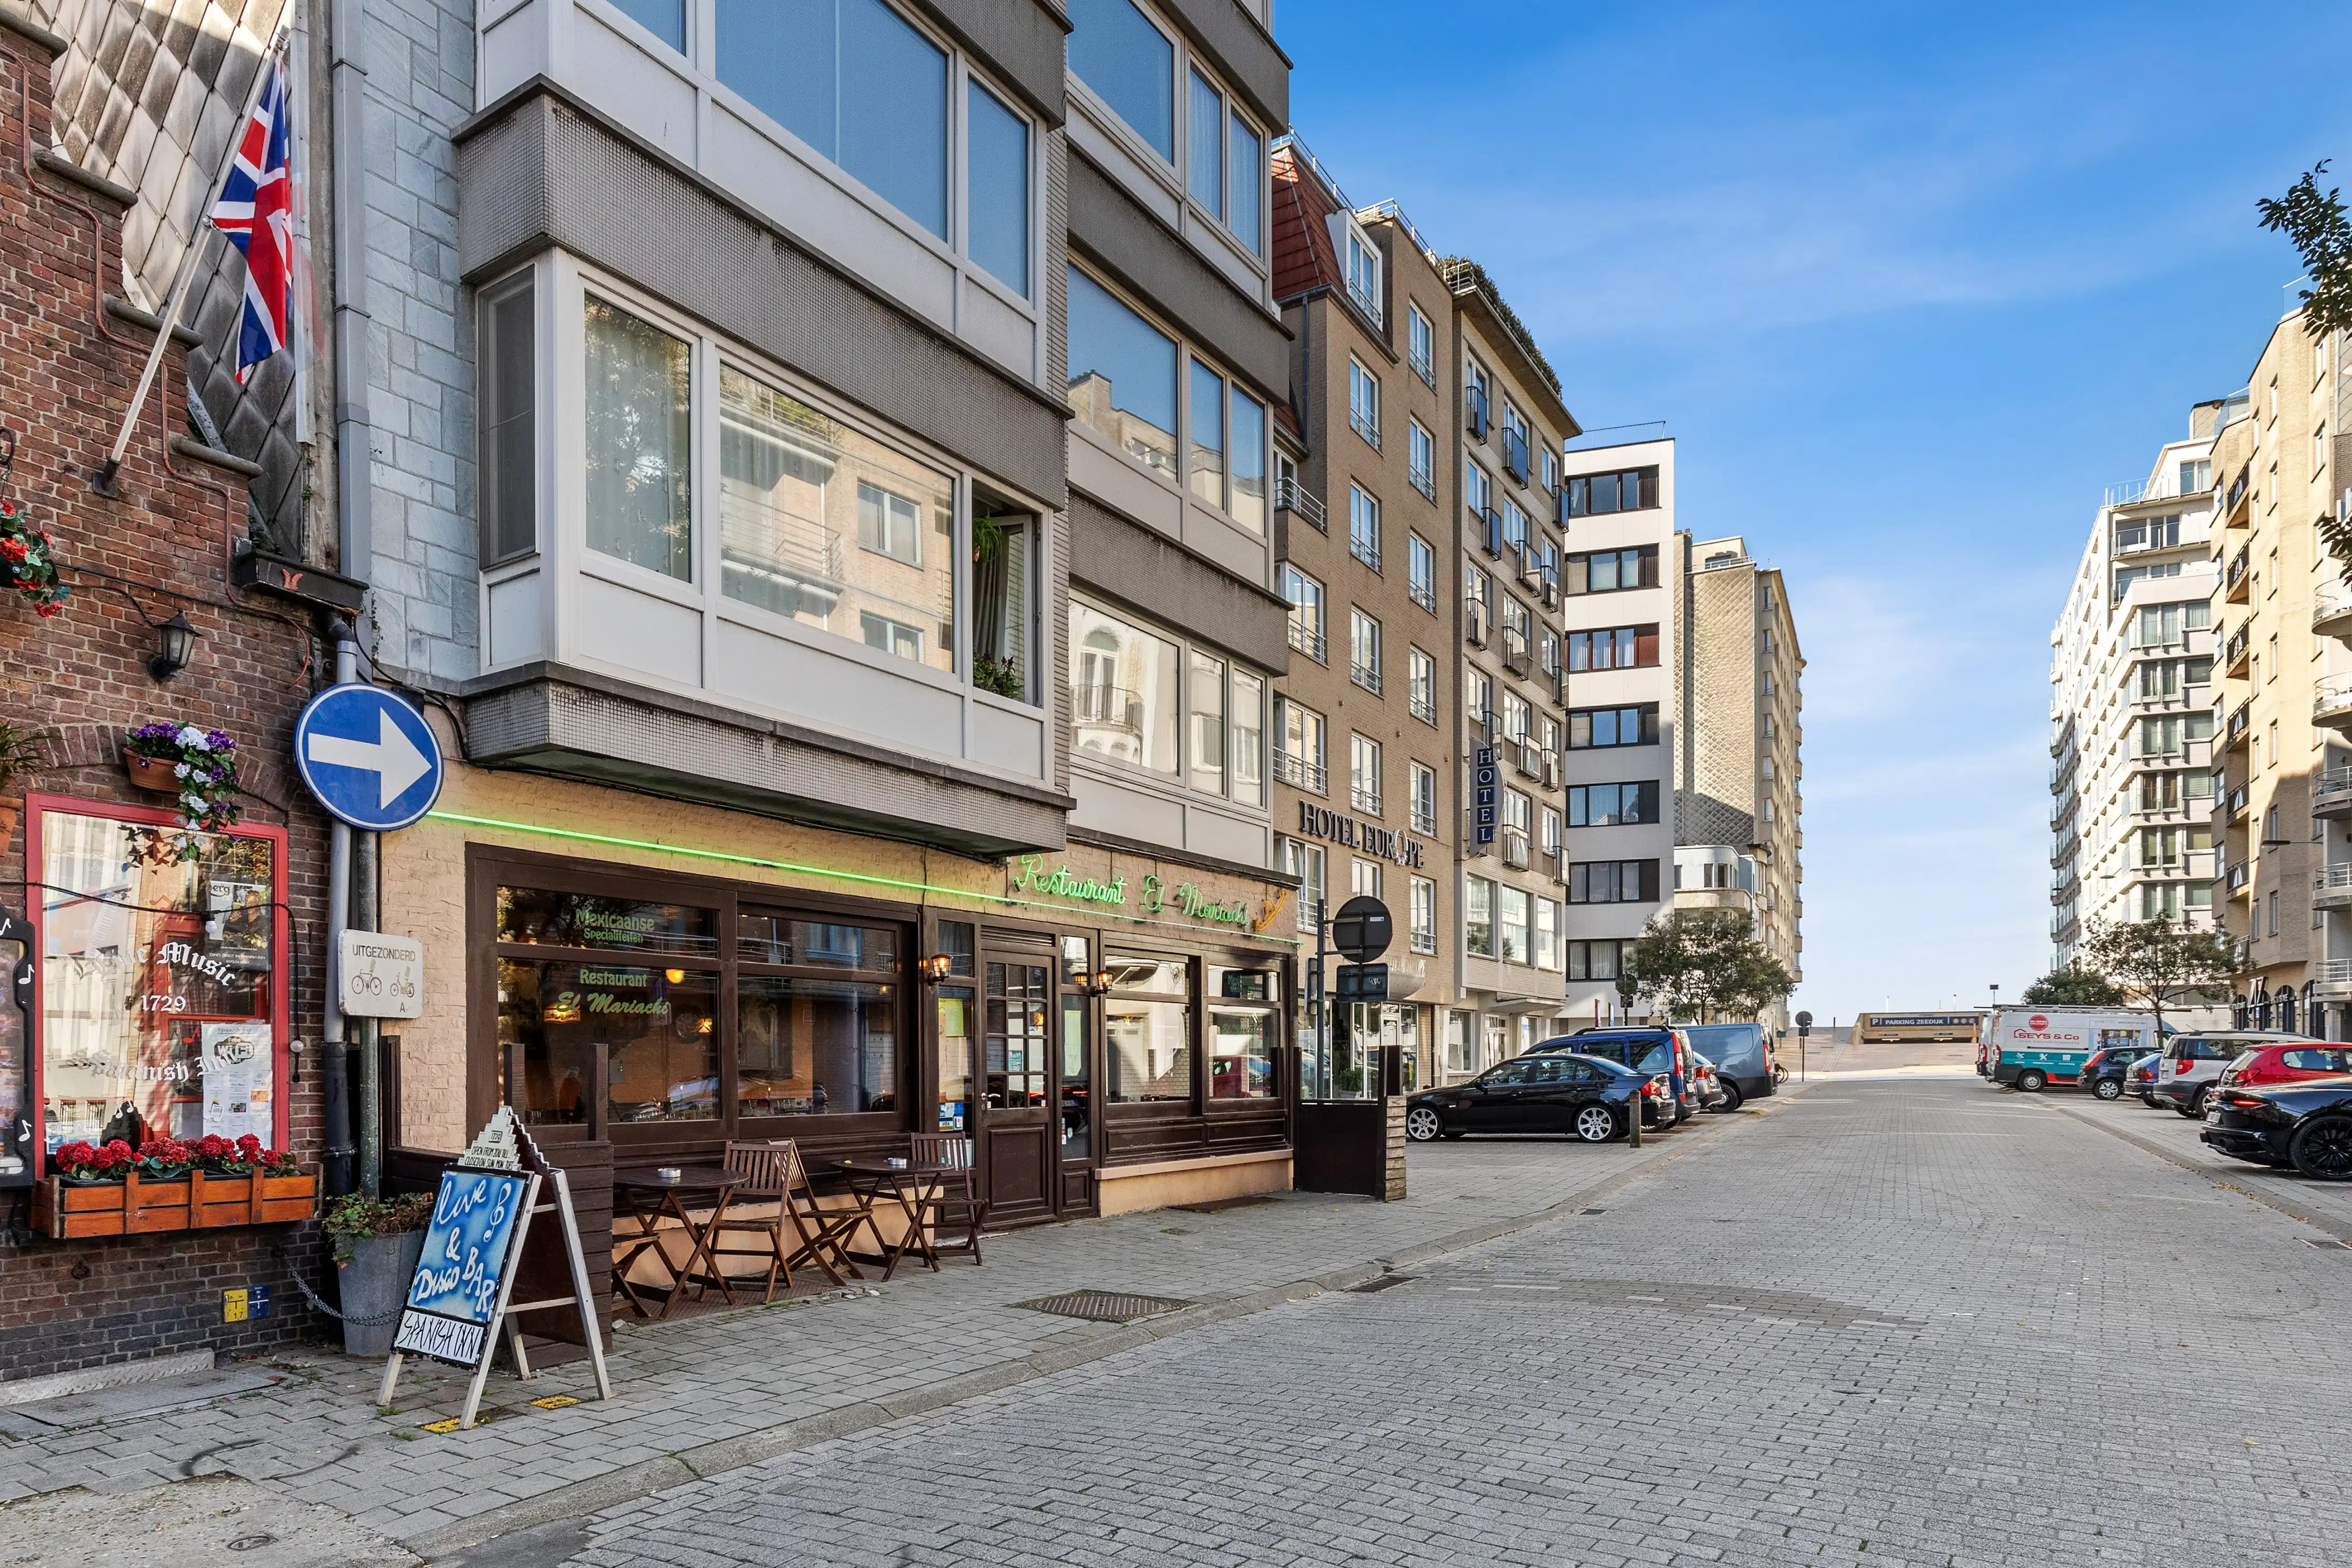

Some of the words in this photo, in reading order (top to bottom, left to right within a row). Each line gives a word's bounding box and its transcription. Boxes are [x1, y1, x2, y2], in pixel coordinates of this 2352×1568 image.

[1478, 750, 1493, 841] HOTEL
[1299, 799, 1360, 849] HOTEL
[1361, 823, 1425, 869] EUROPE
[211, 885, 230, 895] erg
[1013, 853, 1127, 905] Restaurant
[1143, 876, 1166, 912] El
[1179, 882, 1250, 926] Mariachi
[575, 909, 655, 932] Mexicaanse
[584, 928, 643, 943] Specialiteiten
[352, 944, 416, 961] UITGEZONDERD
[156, 942, 236, 986] Music
[580, 968, 647, 987] Restaurant
[141, 994, 186, 1012] 1729
[400, 1002, 406, 1012] A
[556, 992, 581, 1012] El
[587, 992, 668, 1014] Mariachi
[471, 1146, 484, 1155] OPEN
[483, 1147, 493, 1156] FROM
[464, 1156, 479, 1167] CLOSED
[495, 1160, 504, 1169] MON
[446, 1227, 461, 1261] &
[462, 1246, 496, 1313] BAR
[398, 1313, 455, 1355] SPANISH
[454, 1322, 480, 1360] INN
